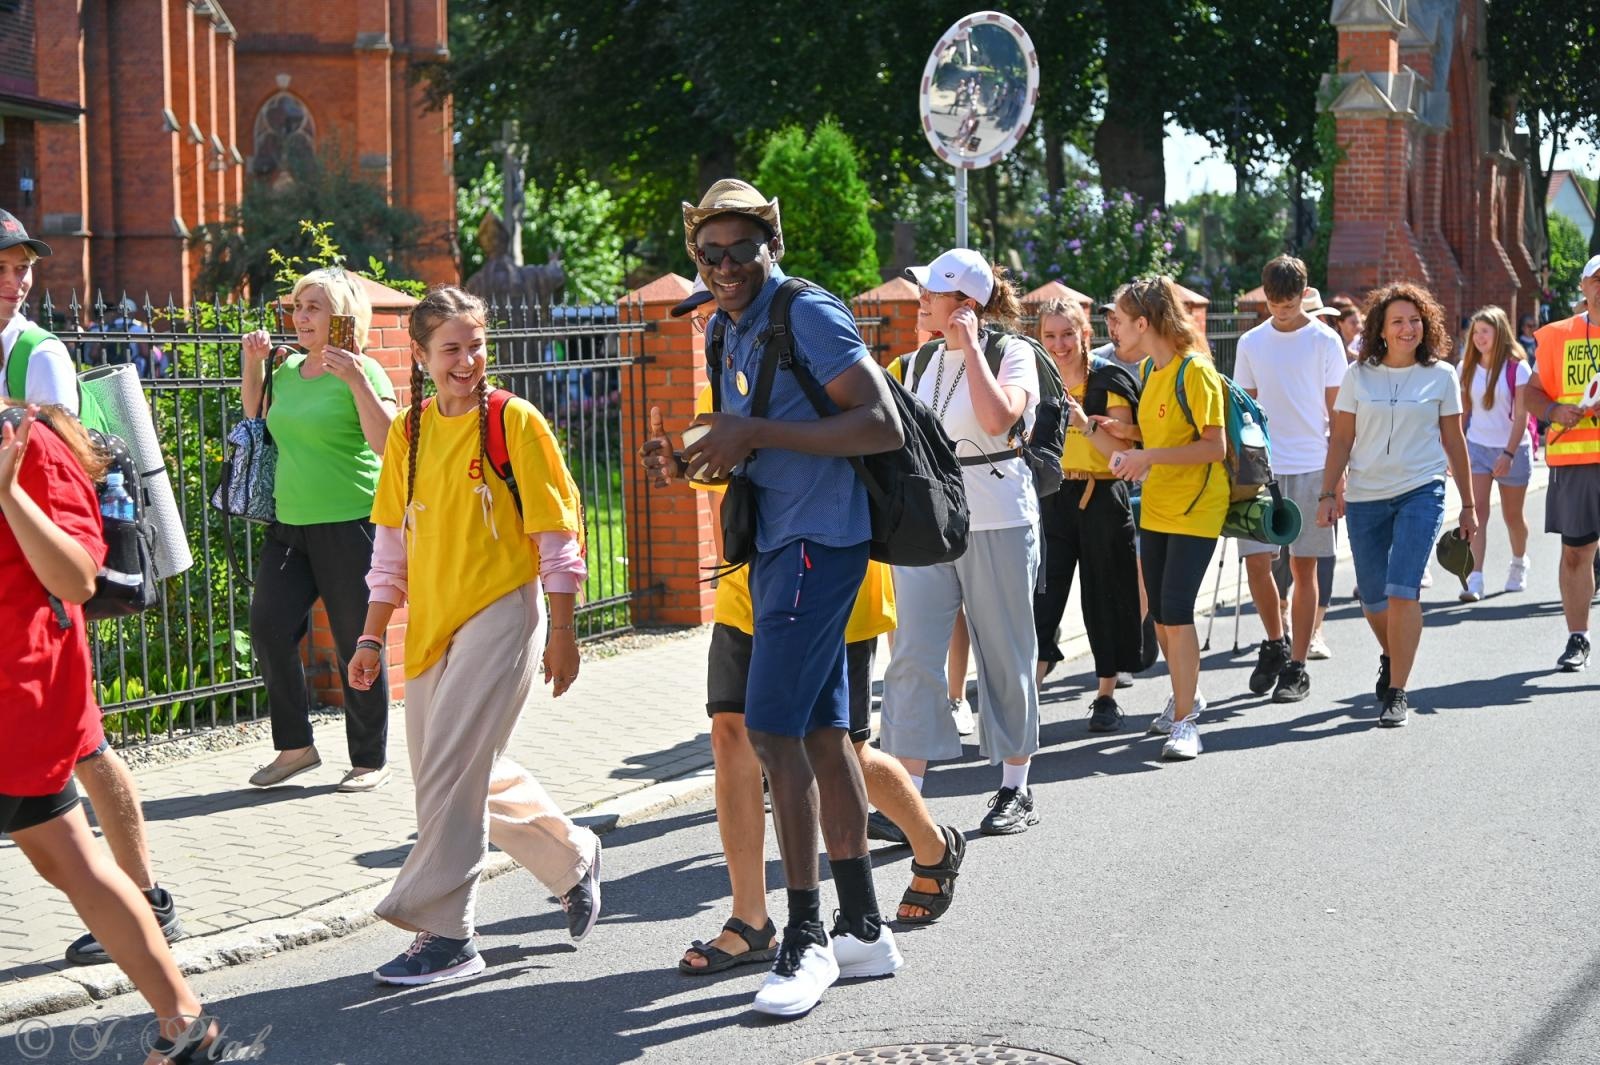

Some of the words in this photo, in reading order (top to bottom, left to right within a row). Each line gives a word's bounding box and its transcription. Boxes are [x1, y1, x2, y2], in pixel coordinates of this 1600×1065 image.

[1568, 344, 1600, 361] KIERO
[1568, 364, 1600, 386] RUC
[1158, 403, 1166, 418] 5
[468, 458, 482, 480] 5
